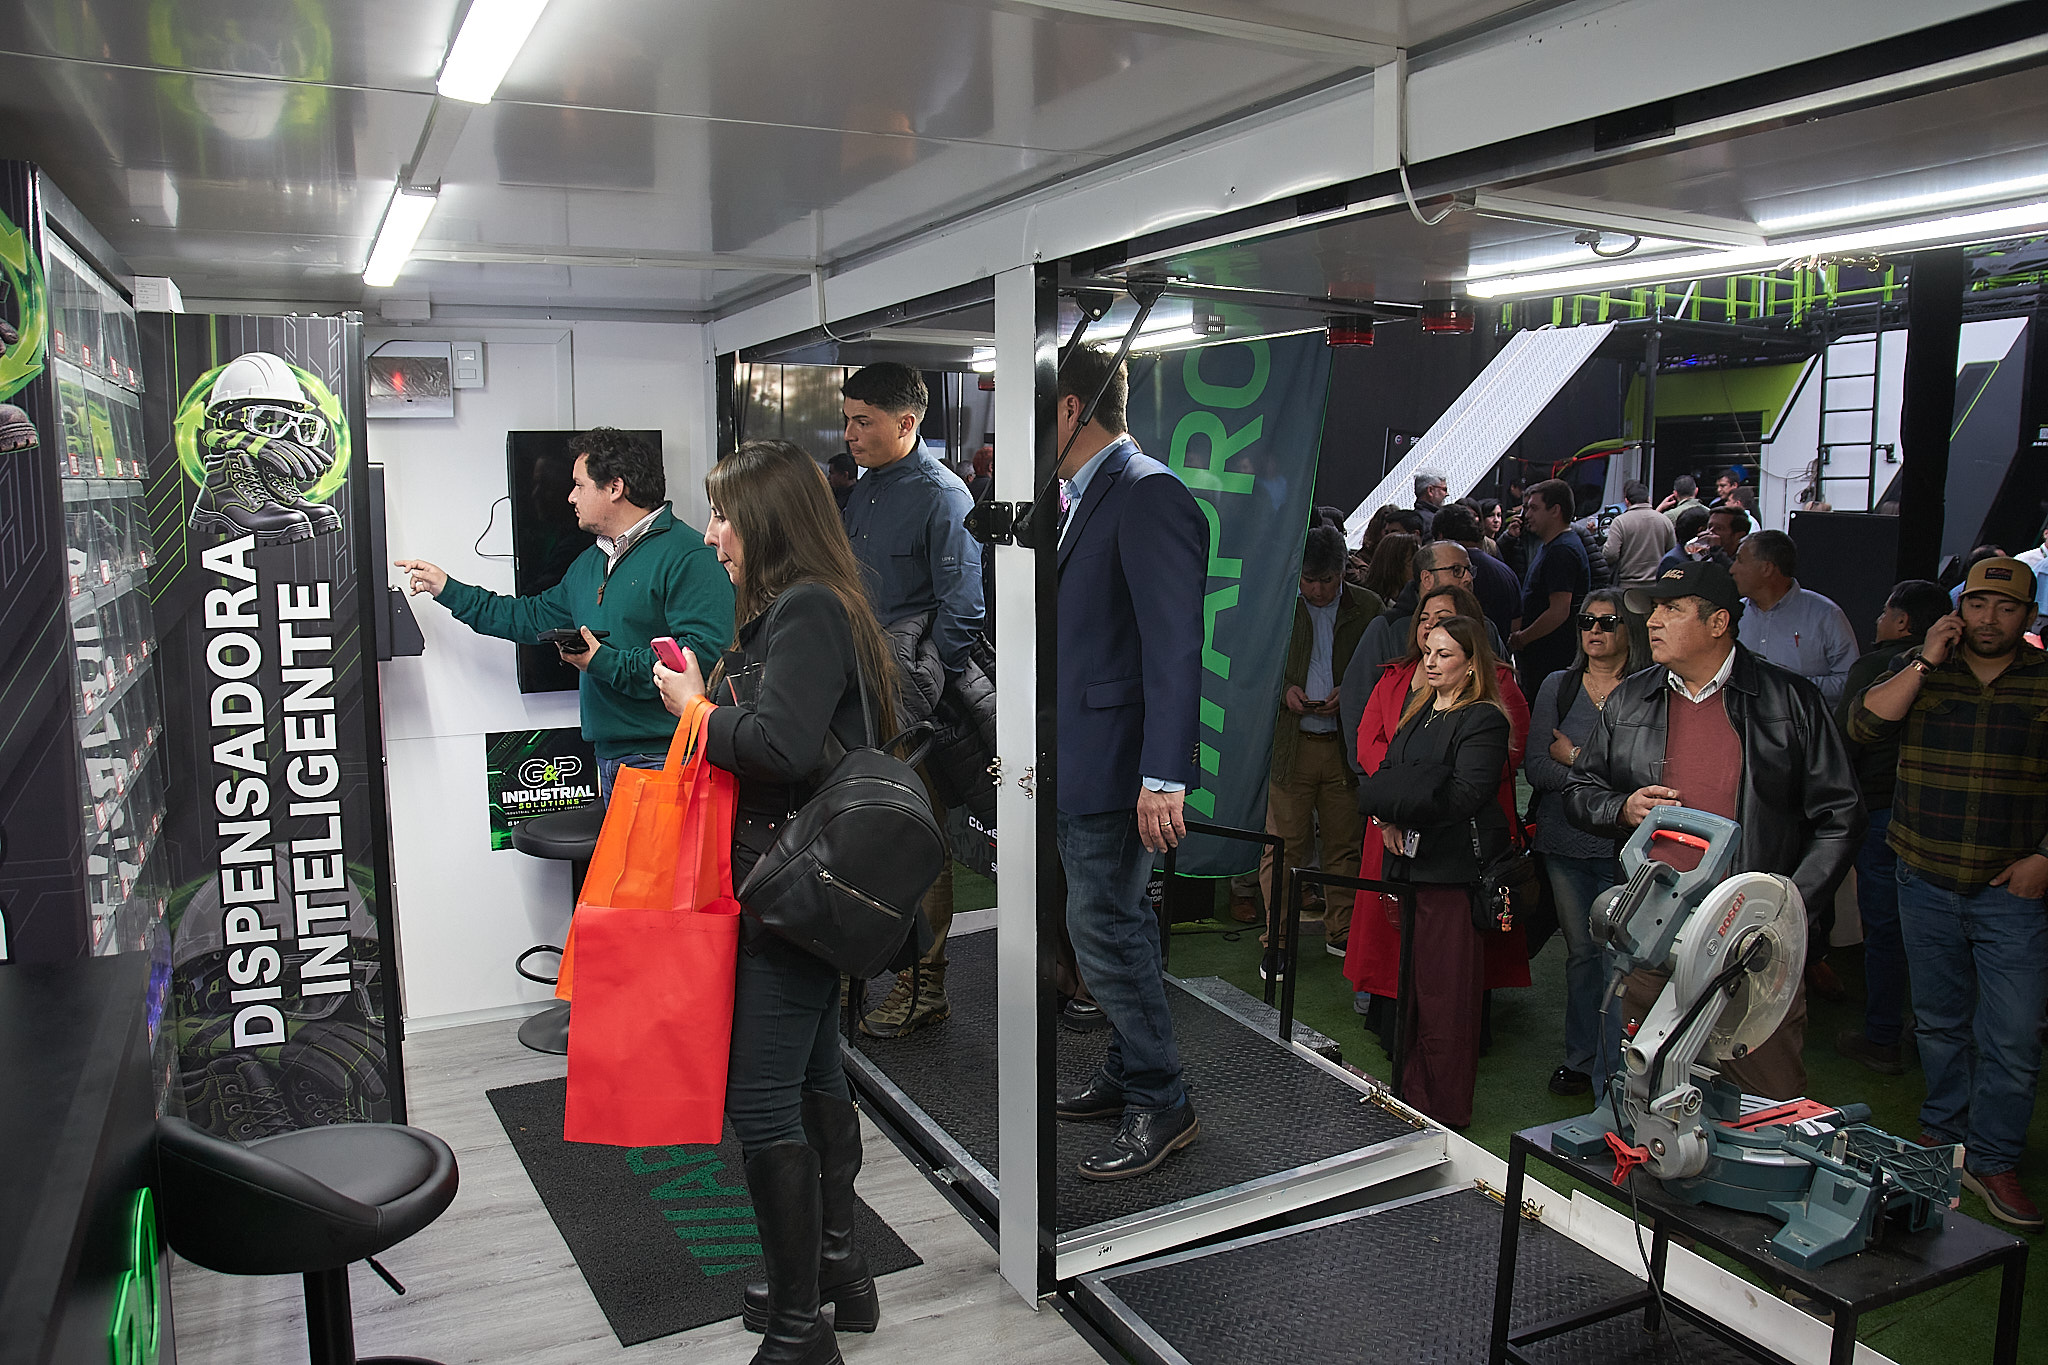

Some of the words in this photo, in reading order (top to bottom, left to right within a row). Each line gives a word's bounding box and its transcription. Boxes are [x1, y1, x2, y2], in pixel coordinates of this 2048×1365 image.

[202, 534, 286, 1048] DISPENSADORA
[277, 583, 352, 997] INTELIGENTE
[518, 756, 582, 788] G&P
[502, 785, 595, 804] INDUSTRIAL
[519, 798, 580, 809] SOLUTIONS
[1717, 892, 1746, 937] BOSCH
